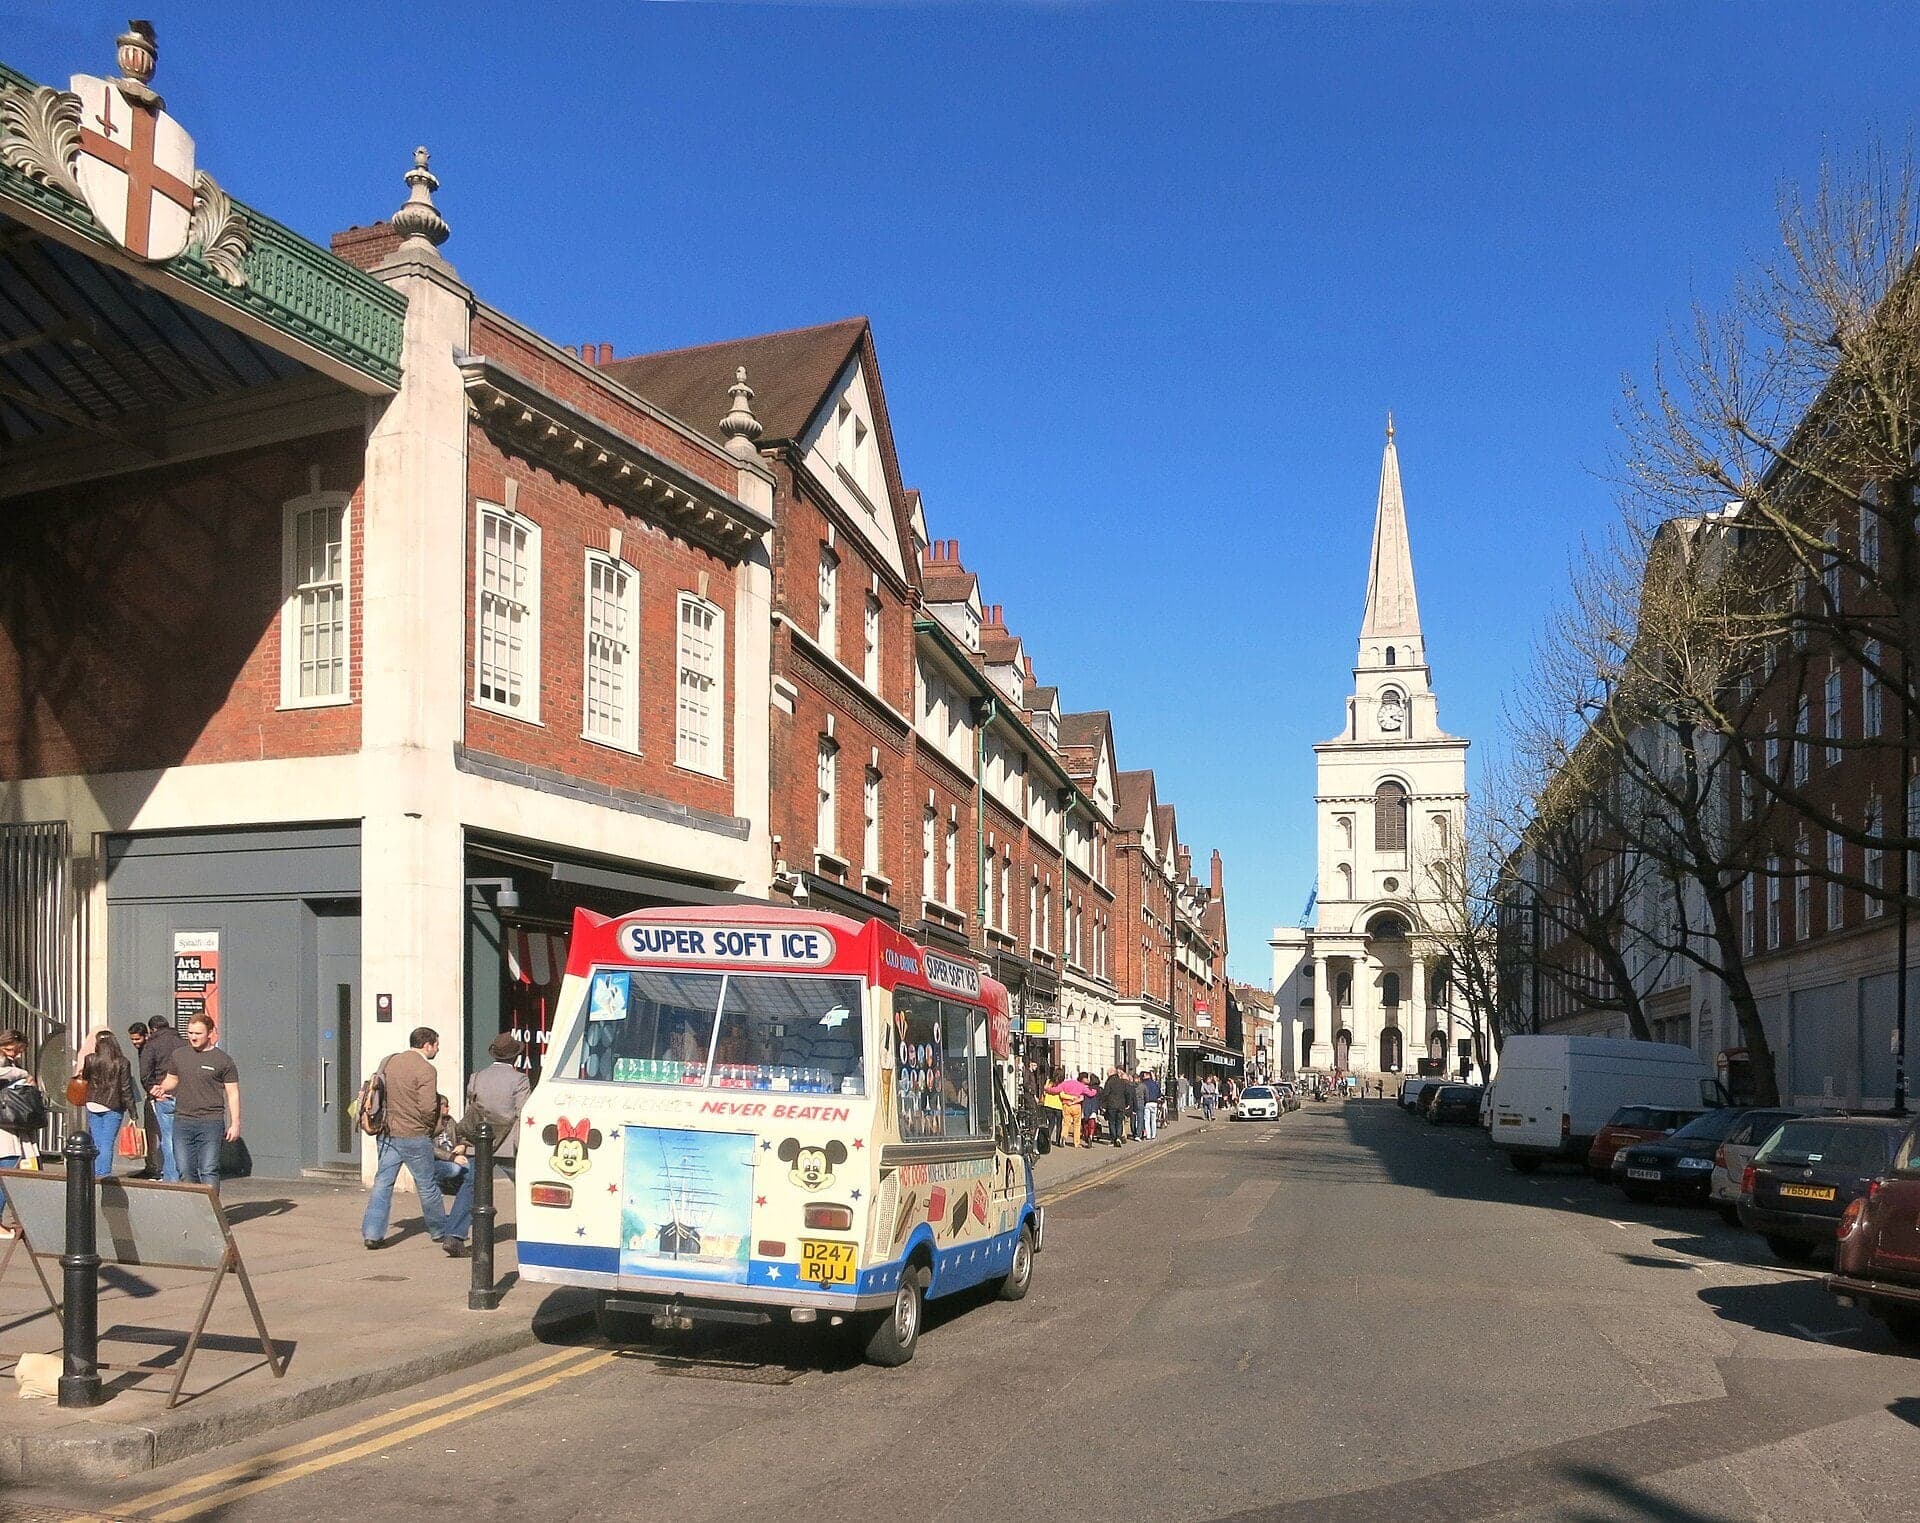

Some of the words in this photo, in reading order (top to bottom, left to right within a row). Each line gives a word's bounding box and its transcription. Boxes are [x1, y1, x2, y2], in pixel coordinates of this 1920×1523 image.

[631, 928, 706, 954] SUPER
[713, 931, 771, 957] SOFT
[781, 934, 819, 959] ICE
[176, 957, 200, 969] Arts
[177, 970, 214, 982] Market
[926, 956, 948, 982] SUPER
[948, 965, 965, 988] SOFT
[965, 968, 977, 992] ICE
[700, 1101, 764, 1117] NEVER
[772, 1104, 850, 1121] BEATEN
[803, 1243, 854, 1262] D247
[809, 1263, 847, 1281] RUJ
